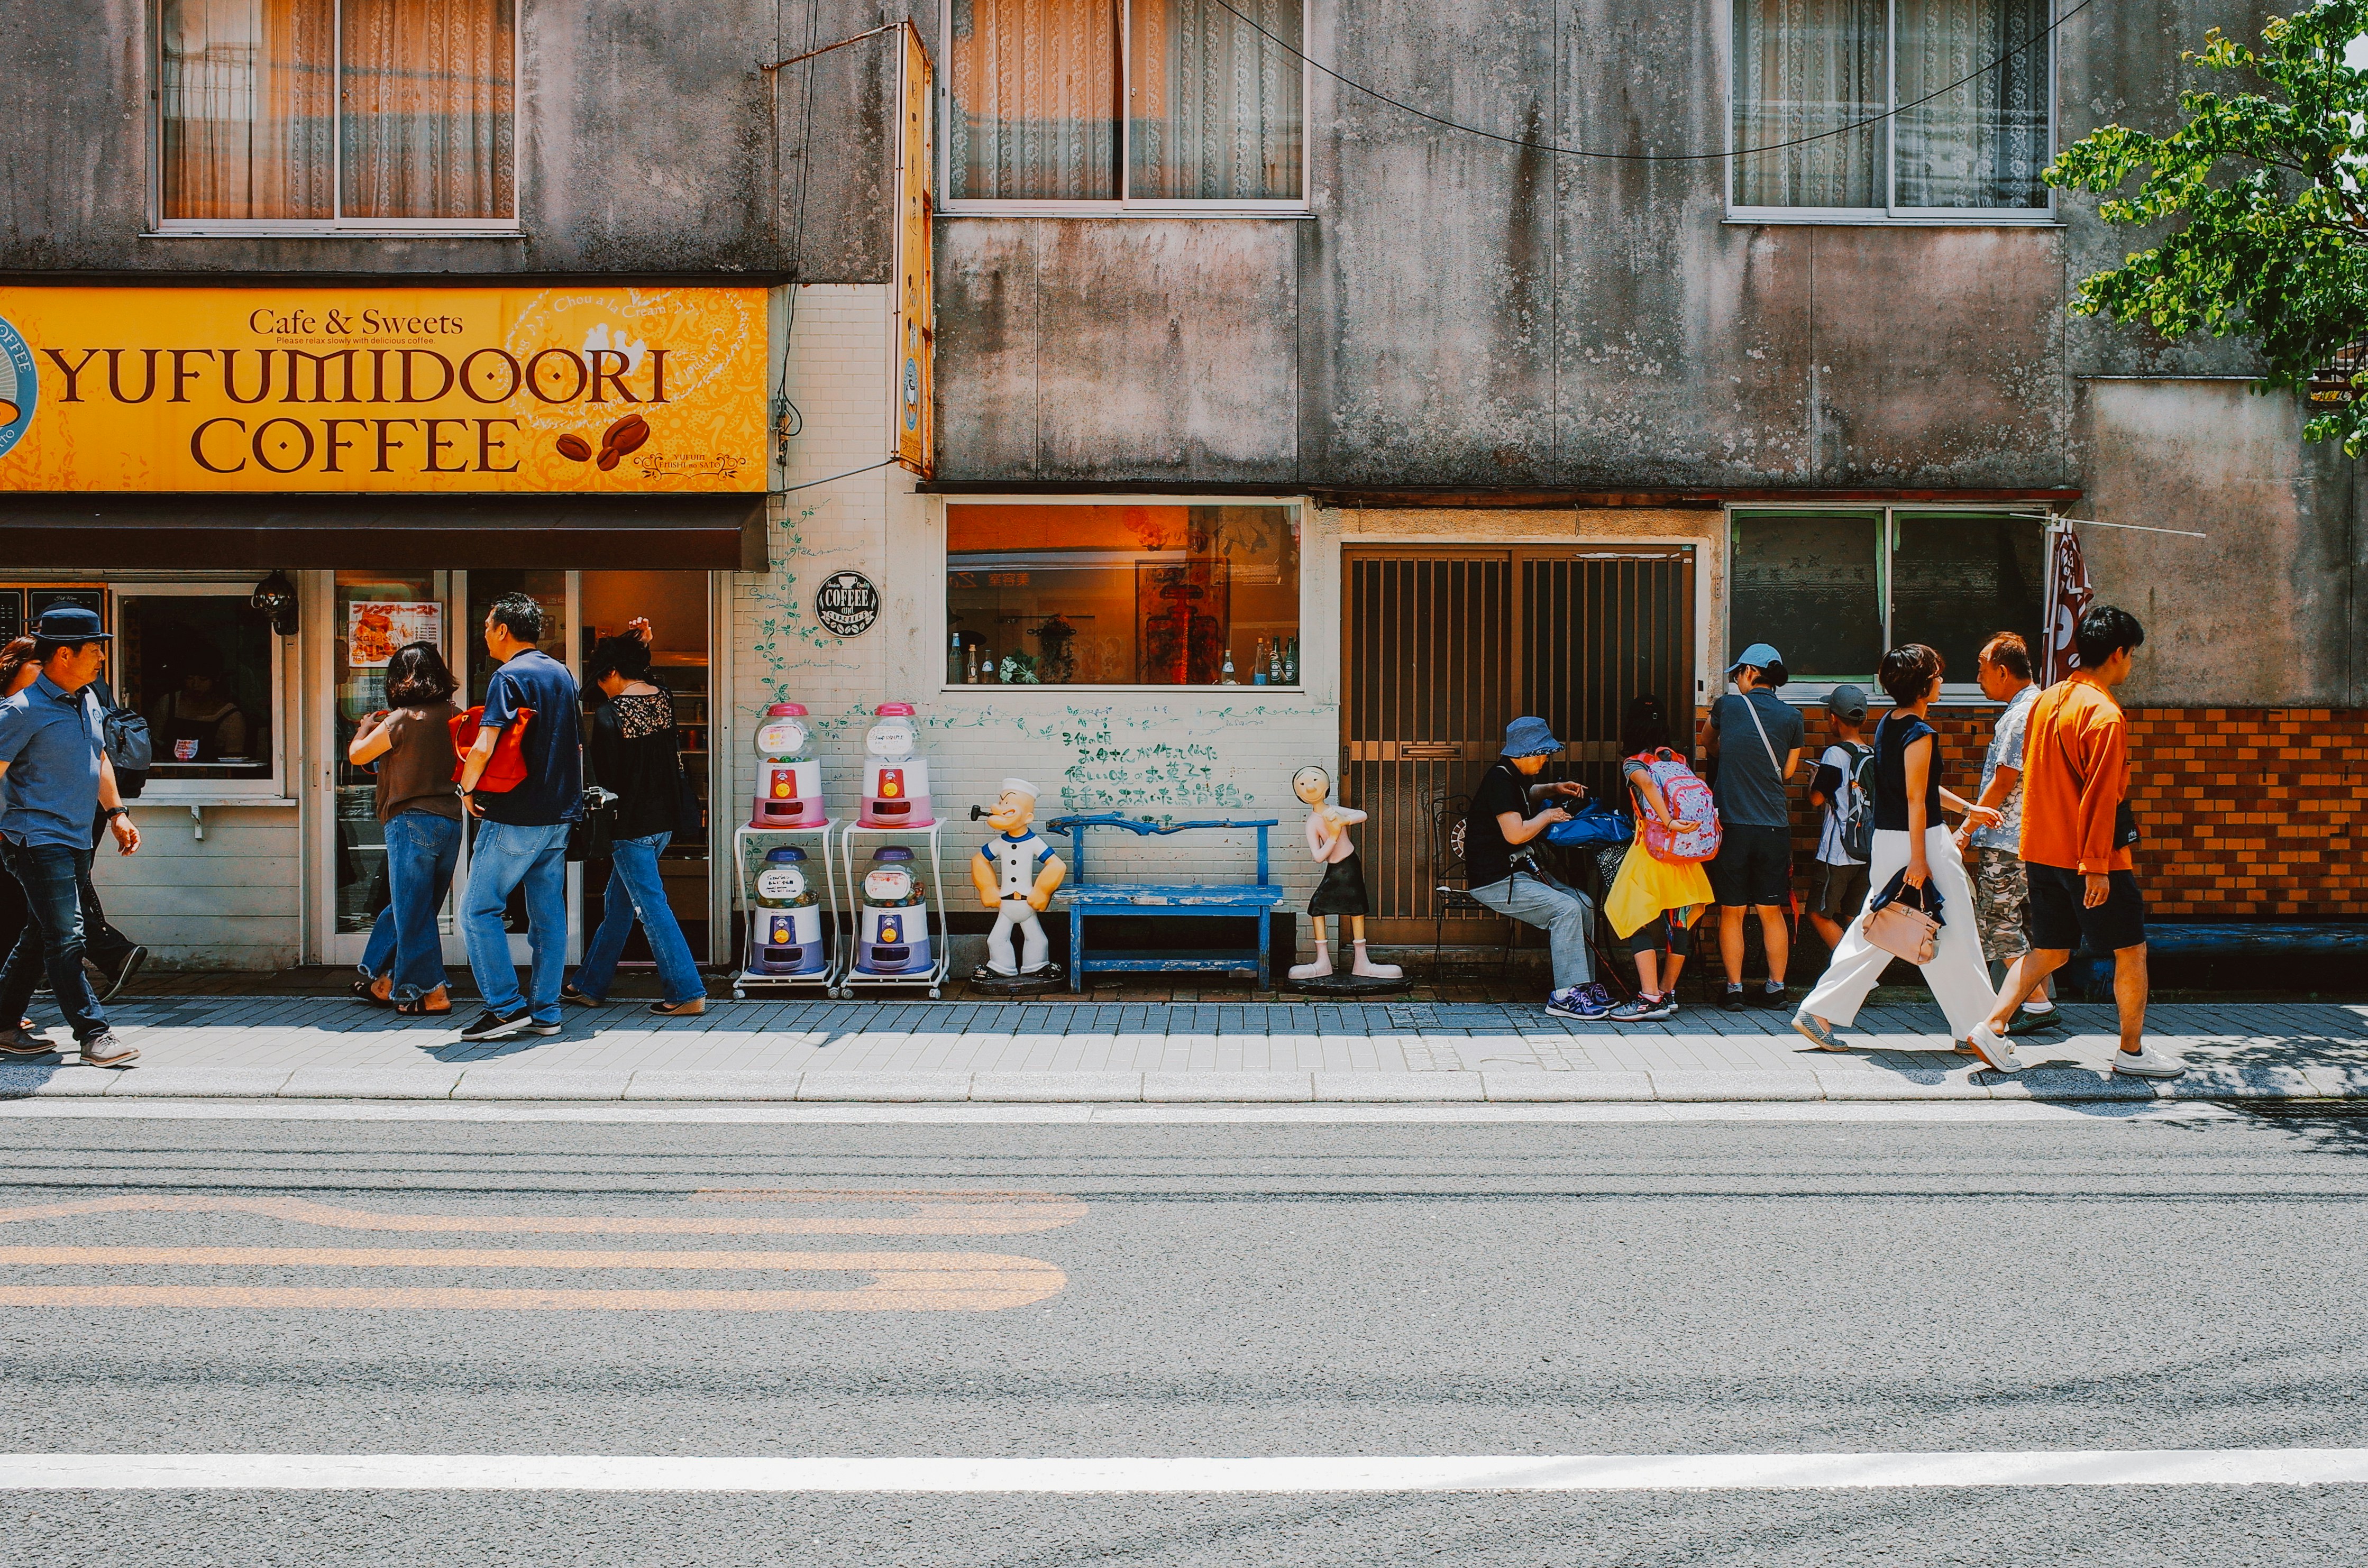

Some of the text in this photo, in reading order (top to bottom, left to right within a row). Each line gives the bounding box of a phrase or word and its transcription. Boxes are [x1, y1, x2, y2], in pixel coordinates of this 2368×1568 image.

[554, 296, 666, 317] Chou a la Cream
[250, 308, 463, 335] Cafe & Sweets
[0, 324, 32, 373] OFFEE
[327, 337, 351, 346] slowly
[683, 328, 726, 380] Caramel
[40, 348, 671, 405] YUFUMIDOORI
[190, 417, 521, 474] COFFEE
[825, 589, 868, 607] COFFEE
[352, 604, 438, 616] フレンチトースト
[828, 611, 866, 623] CUPCAKES
[841, 601, 855, 615] and
[1063, 731, 1112, 746] 子供の頃
